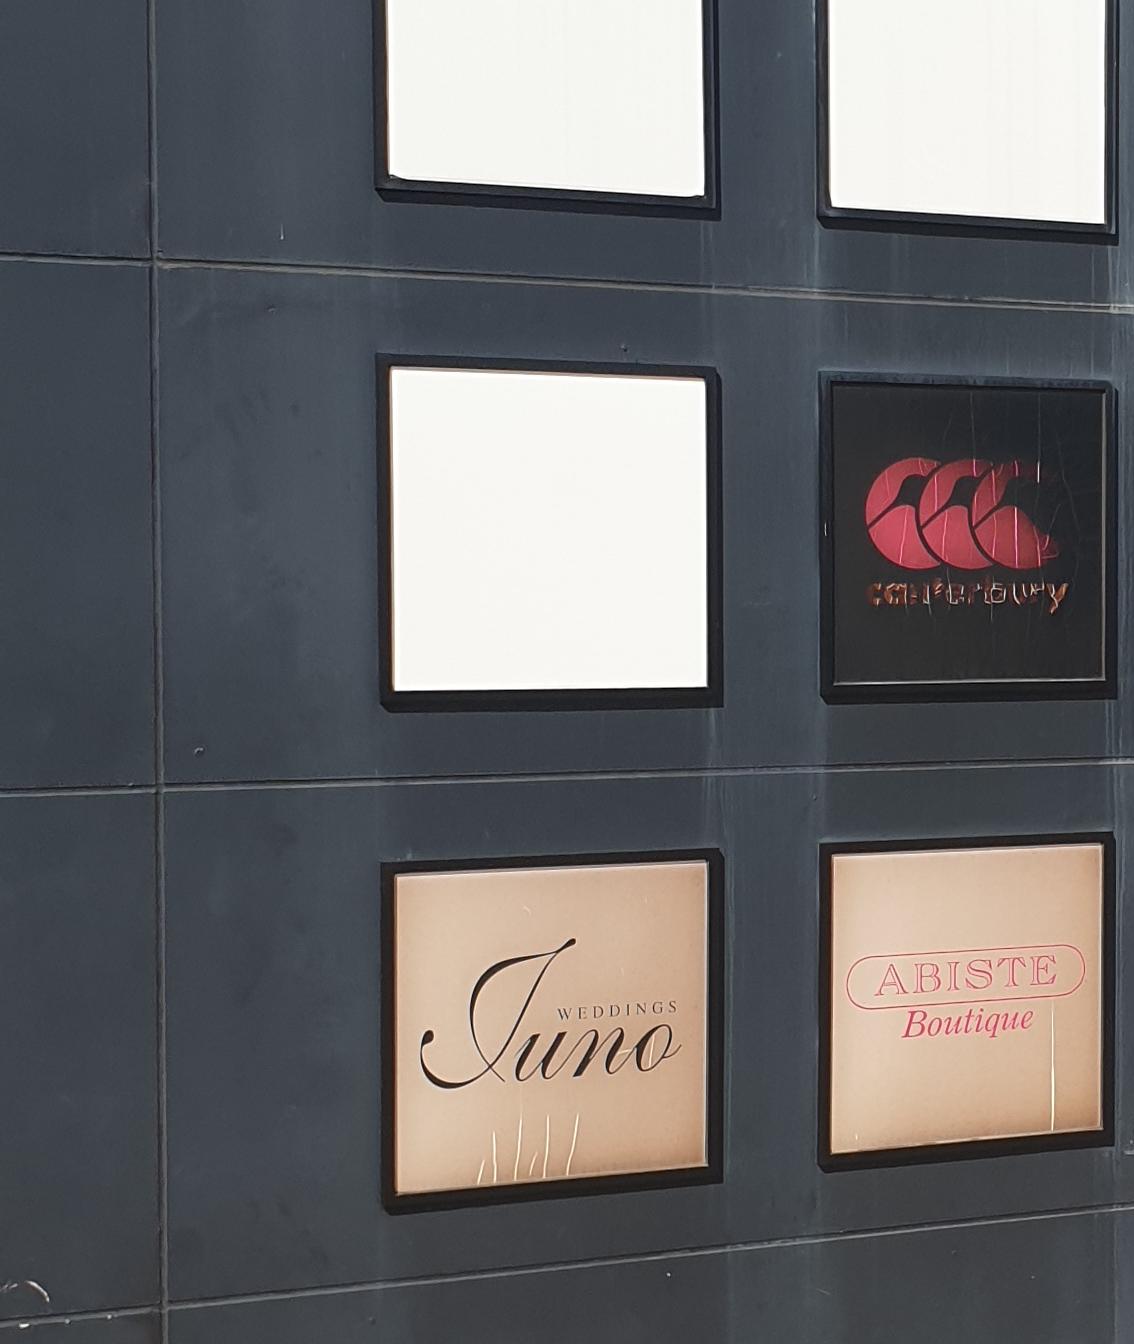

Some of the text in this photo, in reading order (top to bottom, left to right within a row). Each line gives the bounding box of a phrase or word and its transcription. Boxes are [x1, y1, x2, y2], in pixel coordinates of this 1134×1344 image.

[874, 954, 1057, 997] ABISTE
[420, 938, 682, 1089] Juno
[557, 1000, 678, 1021] WEDDINGS
[901, 1008, 1034, 1039] Boutique
